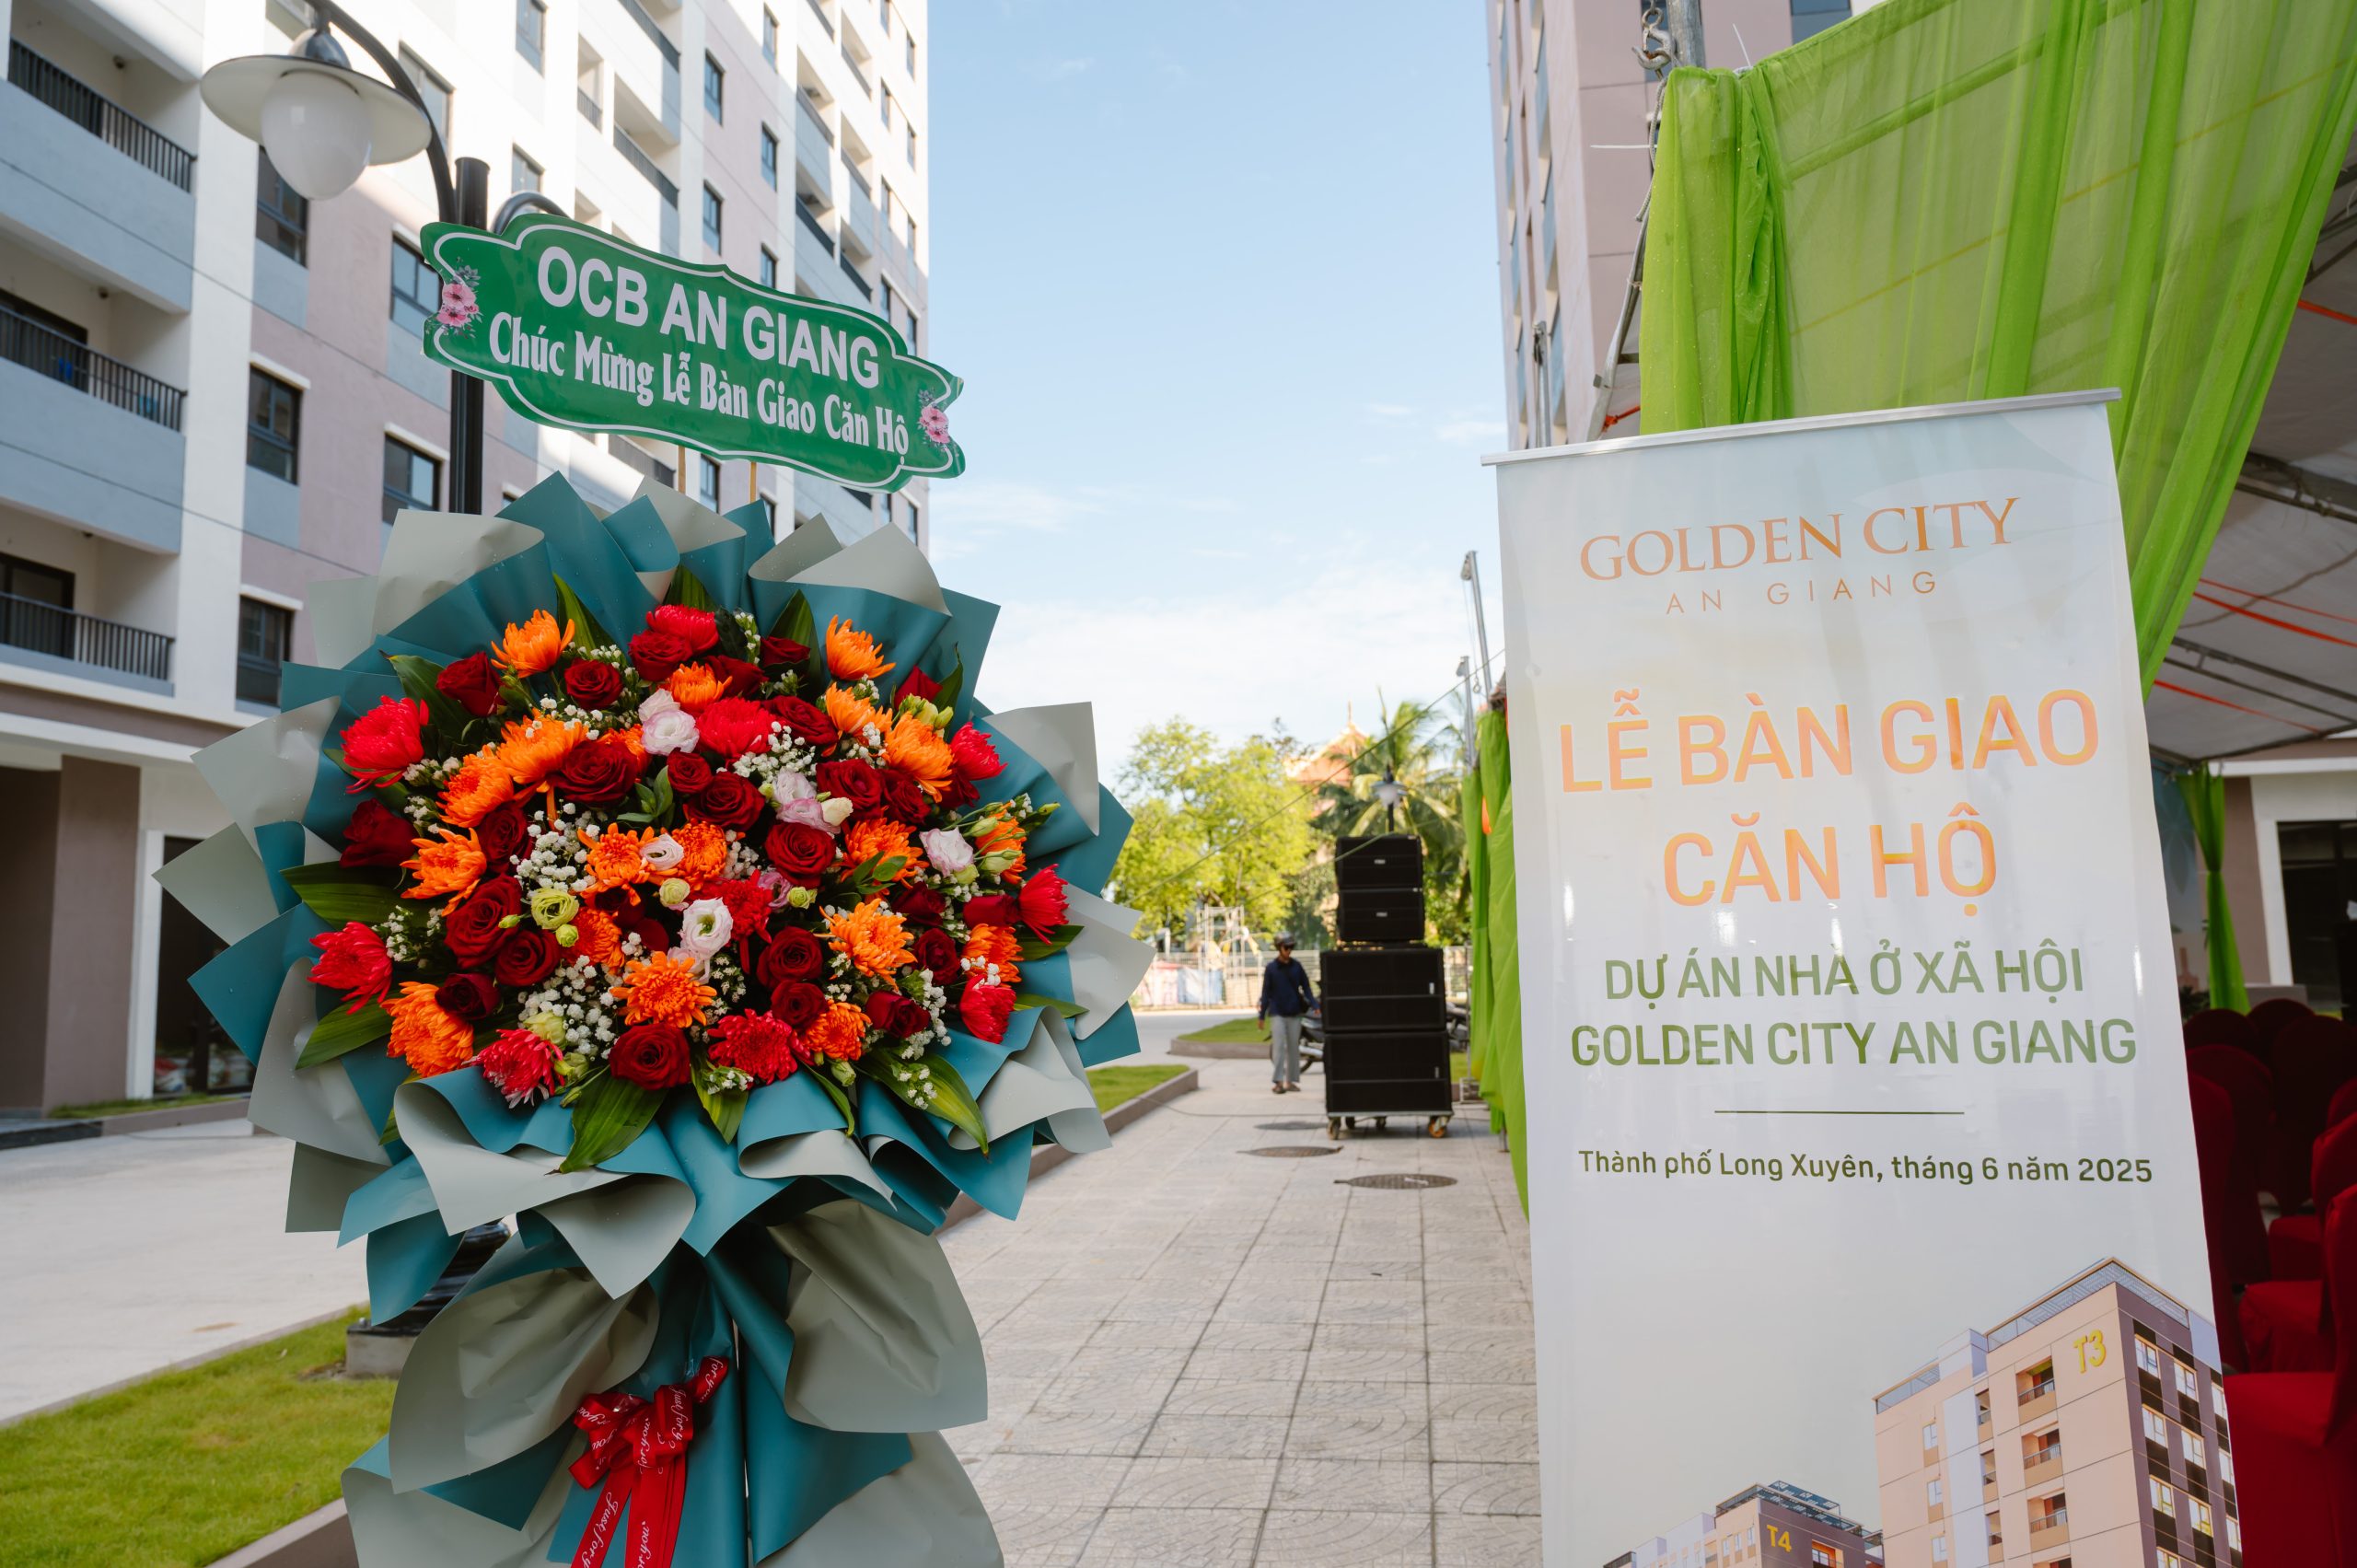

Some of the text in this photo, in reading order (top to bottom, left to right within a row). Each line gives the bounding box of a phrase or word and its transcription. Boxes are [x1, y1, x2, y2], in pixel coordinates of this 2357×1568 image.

[538, 247, 879, 389] OCB AN GIANG
[489, 312, 909, 464] Chúc Mừng Lễ Bàn Giao Căn Hộ
[1580, 497, 2021, 581] GOLDEN CITY
[1666, 571, 1936, 615] AN GIANG
[1560, 689, 2099, 793] LỄ BÀN GIAO
[1663, 801, 1997, 917] CĂN HỘ
[1605, 954, 1667, 1010] DỰ
[1678, 947, 1741, 999] ÁN
[1870, 938, 1902, 995] Ở
[1915, 940, 1985, 994] XÃ
[1995, 938, 2084, 1004] HỘI
[1571, 1018, 2137, 1066] GOLDEN CITY AN GIANG
[1578, 1149, 2153, 1185] Thành phố Long Xuyên, tháng 6 năm 2025
[2073, 1329, 2107, 1374] T3
[590, 1492, 619, 1559] Just for
[1766, 1524, 1792, 1553] T4
